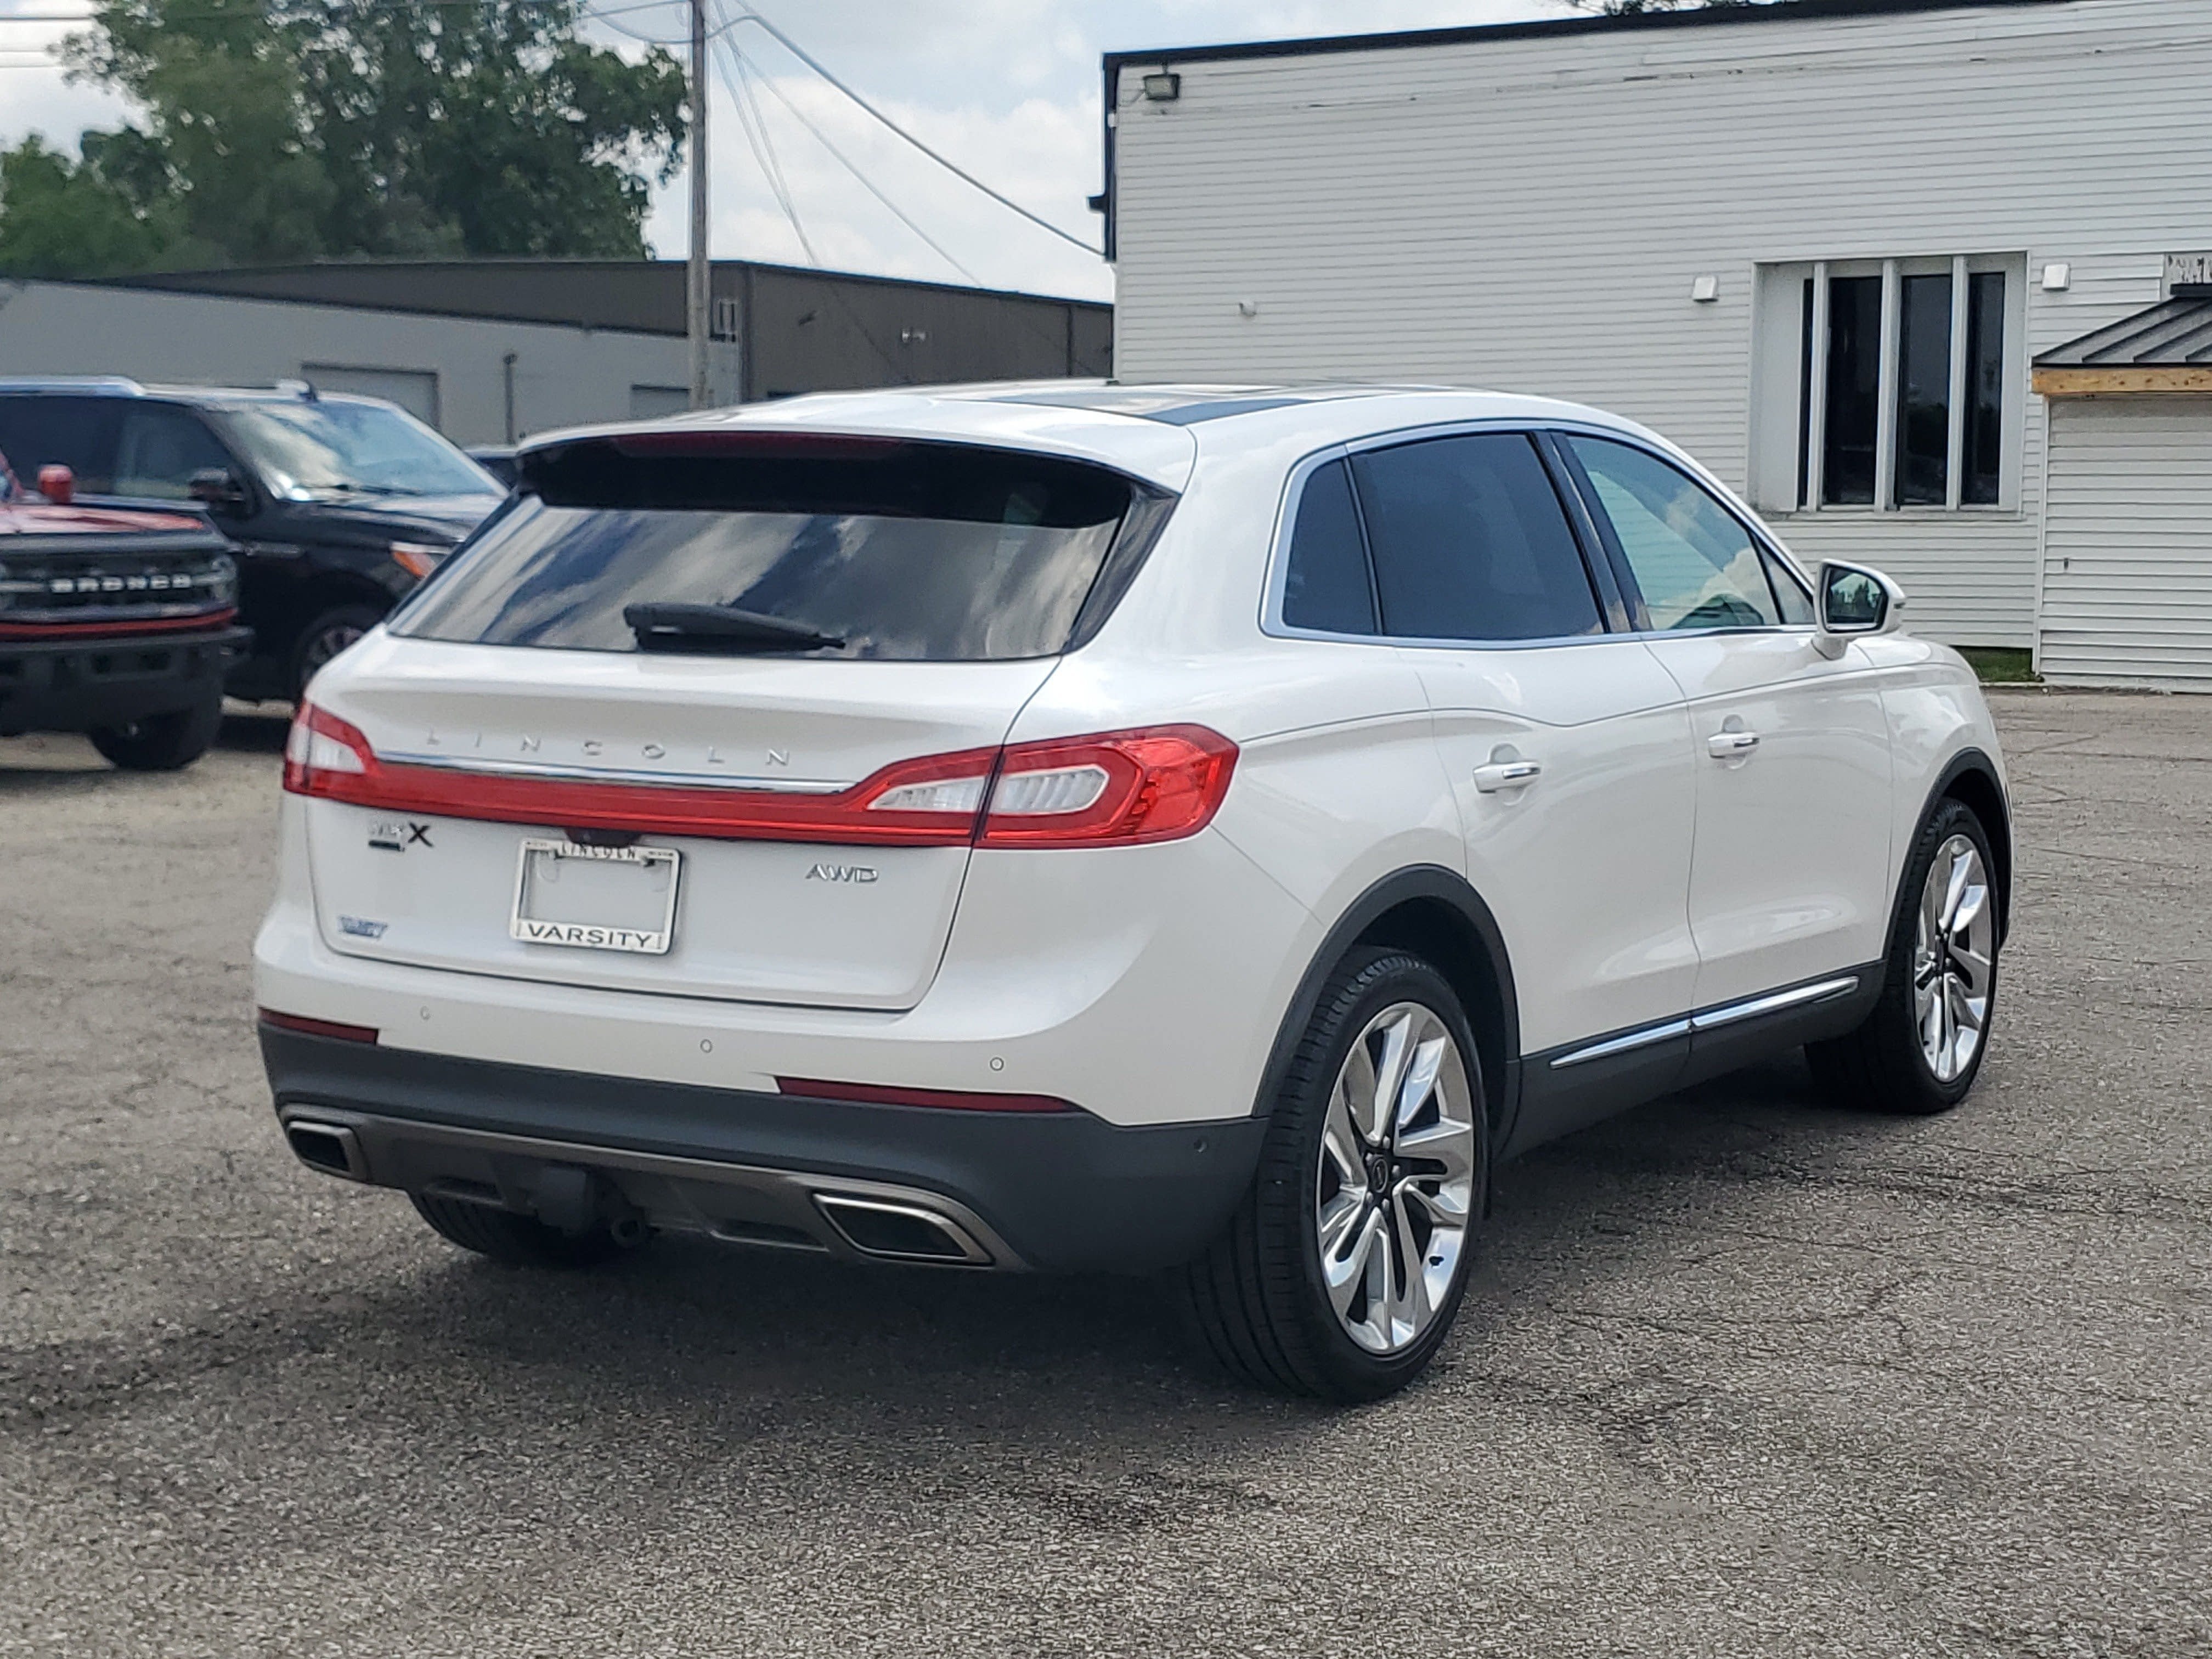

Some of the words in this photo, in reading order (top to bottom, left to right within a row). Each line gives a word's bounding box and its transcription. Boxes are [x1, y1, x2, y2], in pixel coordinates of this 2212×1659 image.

[427, 727, 790, 766] LINCOLN
[805, 863, 878, 883] AWD
[528, 923, 652, 953] VARSITY
